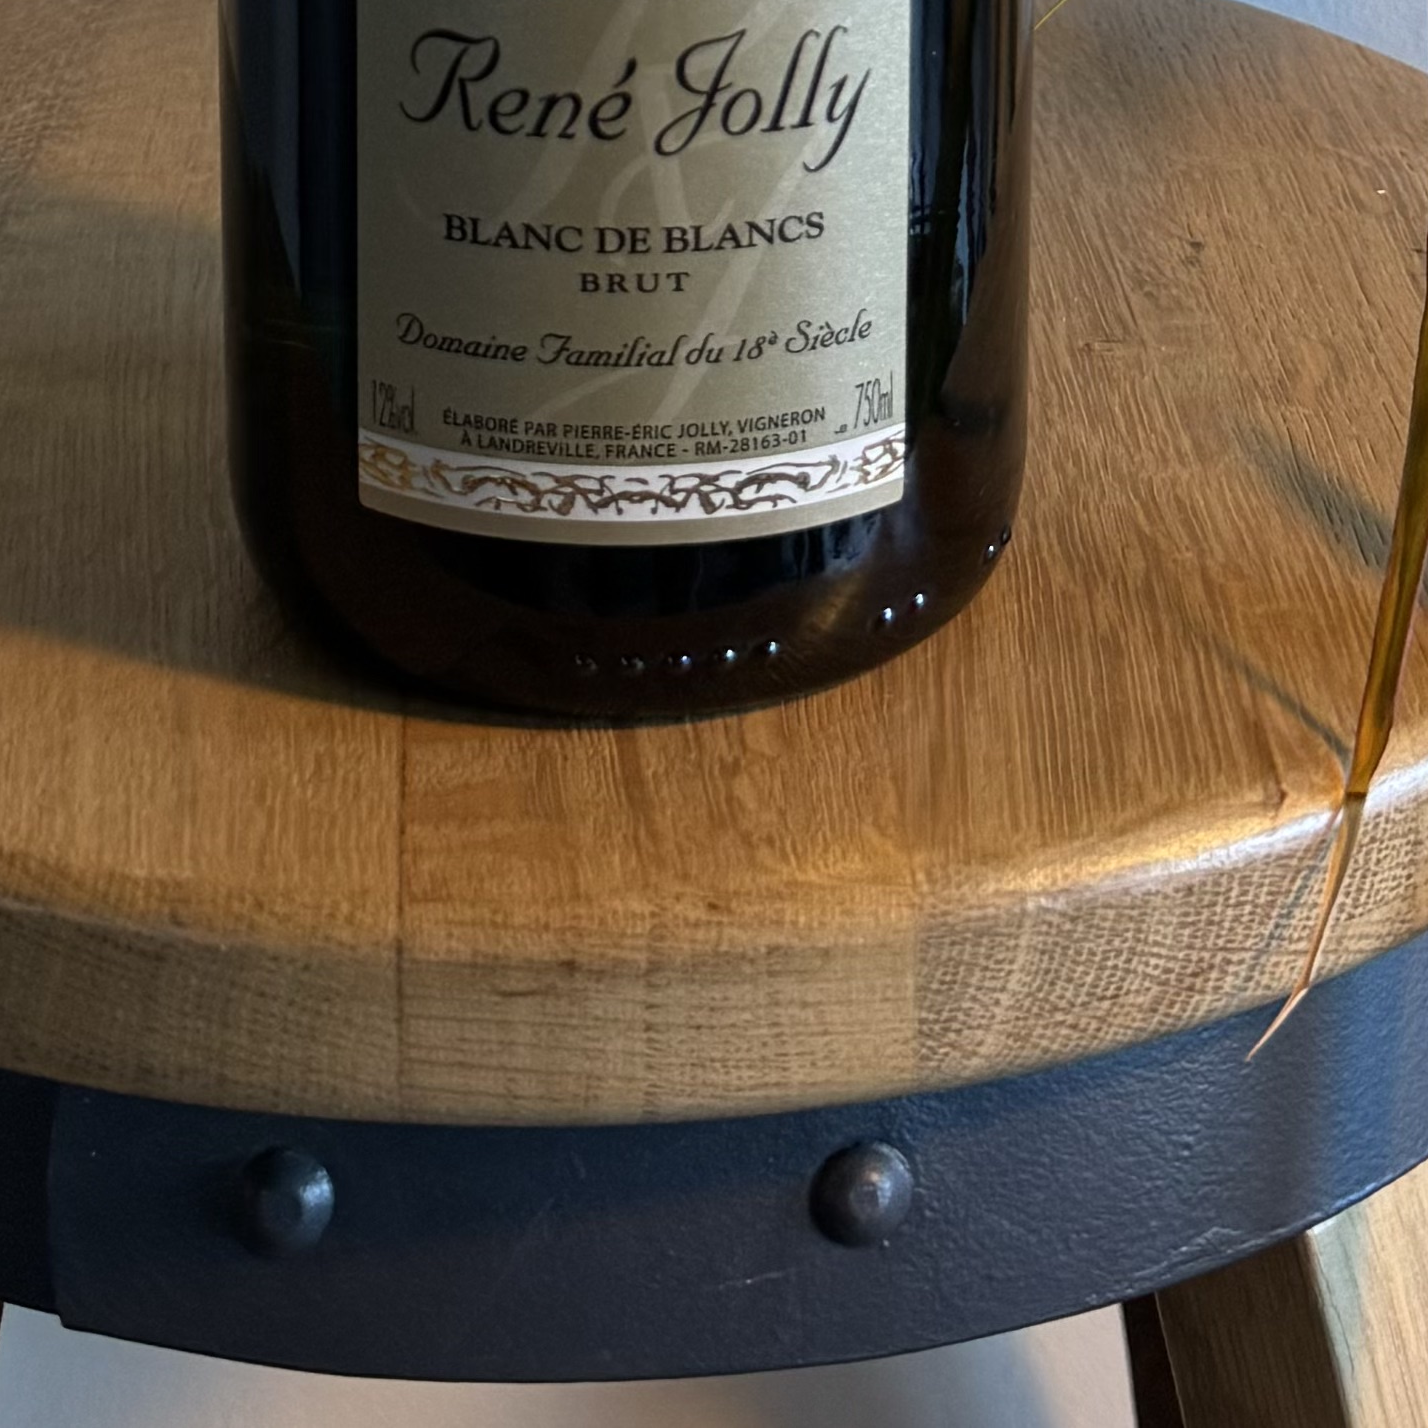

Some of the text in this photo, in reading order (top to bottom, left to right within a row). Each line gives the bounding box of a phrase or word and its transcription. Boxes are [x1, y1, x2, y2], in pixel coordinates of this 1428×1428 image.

[398, 24, 872, 174] René Jolly
[443, 211, 826, 256] BLANC DE BLANCS
[579, 271, 690, 295] BRUT
[395, 312, 529, 362] Domaine
[536, 332, 688, 368] Familial
[684, 332, 724, 365] du
[785, 308, 873, 354] Siècle
[443, 406, 827, 441] ÉLABORÉ PAR PIERRE-ÉRIC JOLLY, VIGNERON
[460, 429, 473, 447] À
[478, 435, 601, 461] LANDREVILLE,
[606, 443, 677, 460] FRANCE
[694, 429, 808, 457] RM-28163-01
